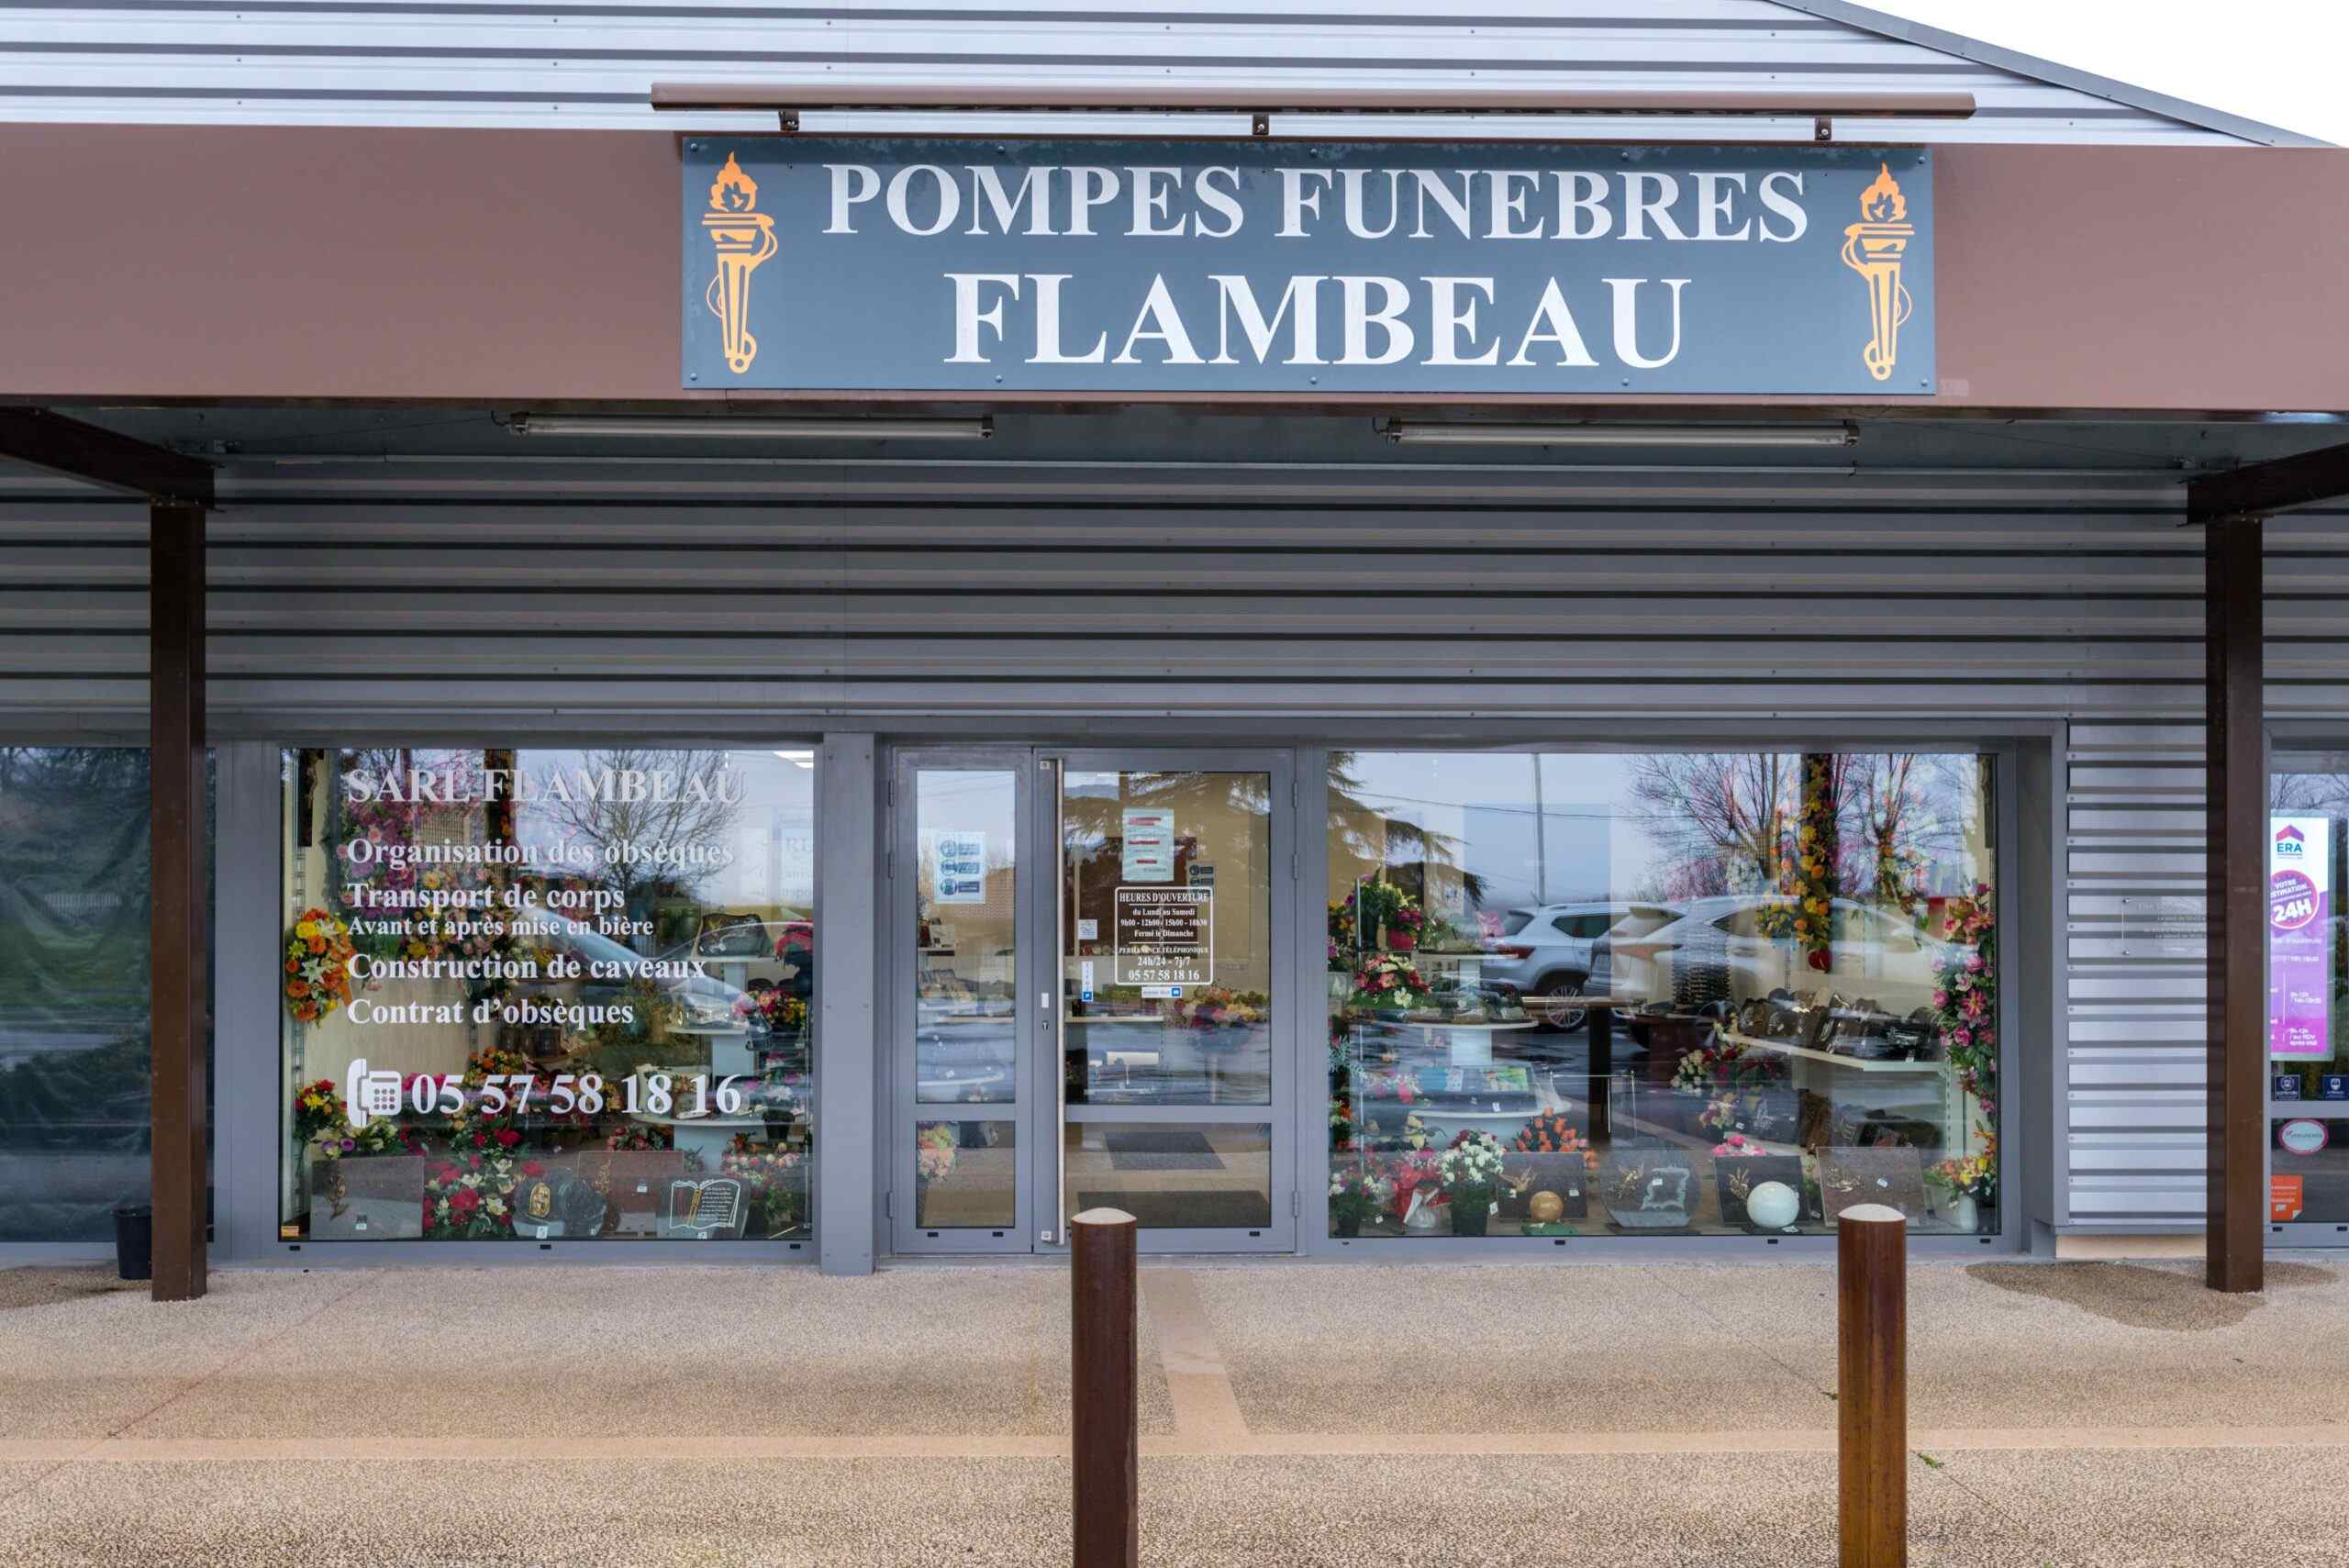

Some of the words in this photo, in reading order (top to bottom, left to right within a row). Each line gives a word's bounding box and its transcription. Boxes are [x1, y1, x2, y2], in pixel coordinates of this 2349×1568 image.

[822, 165, 1244, 238] POMPES
[1275, 168, 1809, 243] FUNEBRES
[943, 272, 1692, 369] FLAMBEAU
[348, 769, 472, 803] SARL
[483, 769, 747, 804] FLAMBEAU
[347, 838, 538, 871] Organisation
[549, 839, 595, 863] des
[604, 839, 734, 871] obsèques
[2277, 843, 2303, 852] ERA
[347, 883, 495, 915] Transport
[503, 884, 538, 908] de
[546, 889, 625, 916] corps
[1119, 893, 1152, 902] HEURES
[2273, 897, 2312, 922] 24H
[348, 917, 412, 936] Avant
[417, 917, 436, 936] et
[445, 917, 504, 940] après
[511, 917, 560, 936] mise
[566, 920, 592, 936] en
[599, 917, 654, 936] bière
[348, 953, 539, 979] Construction
[547, 954, 581, 979] de
[590, 959, 707, 980] caveaux
[1129, 970, 1141, 981] 05
[1143, 970, 1155, 981] 57
[1158, 970, 1171, 981] 58
[1173, 970, 1185, 981] 18
[1188, 970, 1200, 981] 16
[1137, 956, 1166, 965] 24h/24
[347, 998, 464, 1025] Contrat
[472, 998, 633, 1031] d'obsèques
[412, 1073, 465, 1114] 05
[480, 1073, 536, 1114] 57
[551, 1073, 604, 1114] 58
[620, 1073, 674, 1114] 18
[689, 1073, 741, 1114] 16
